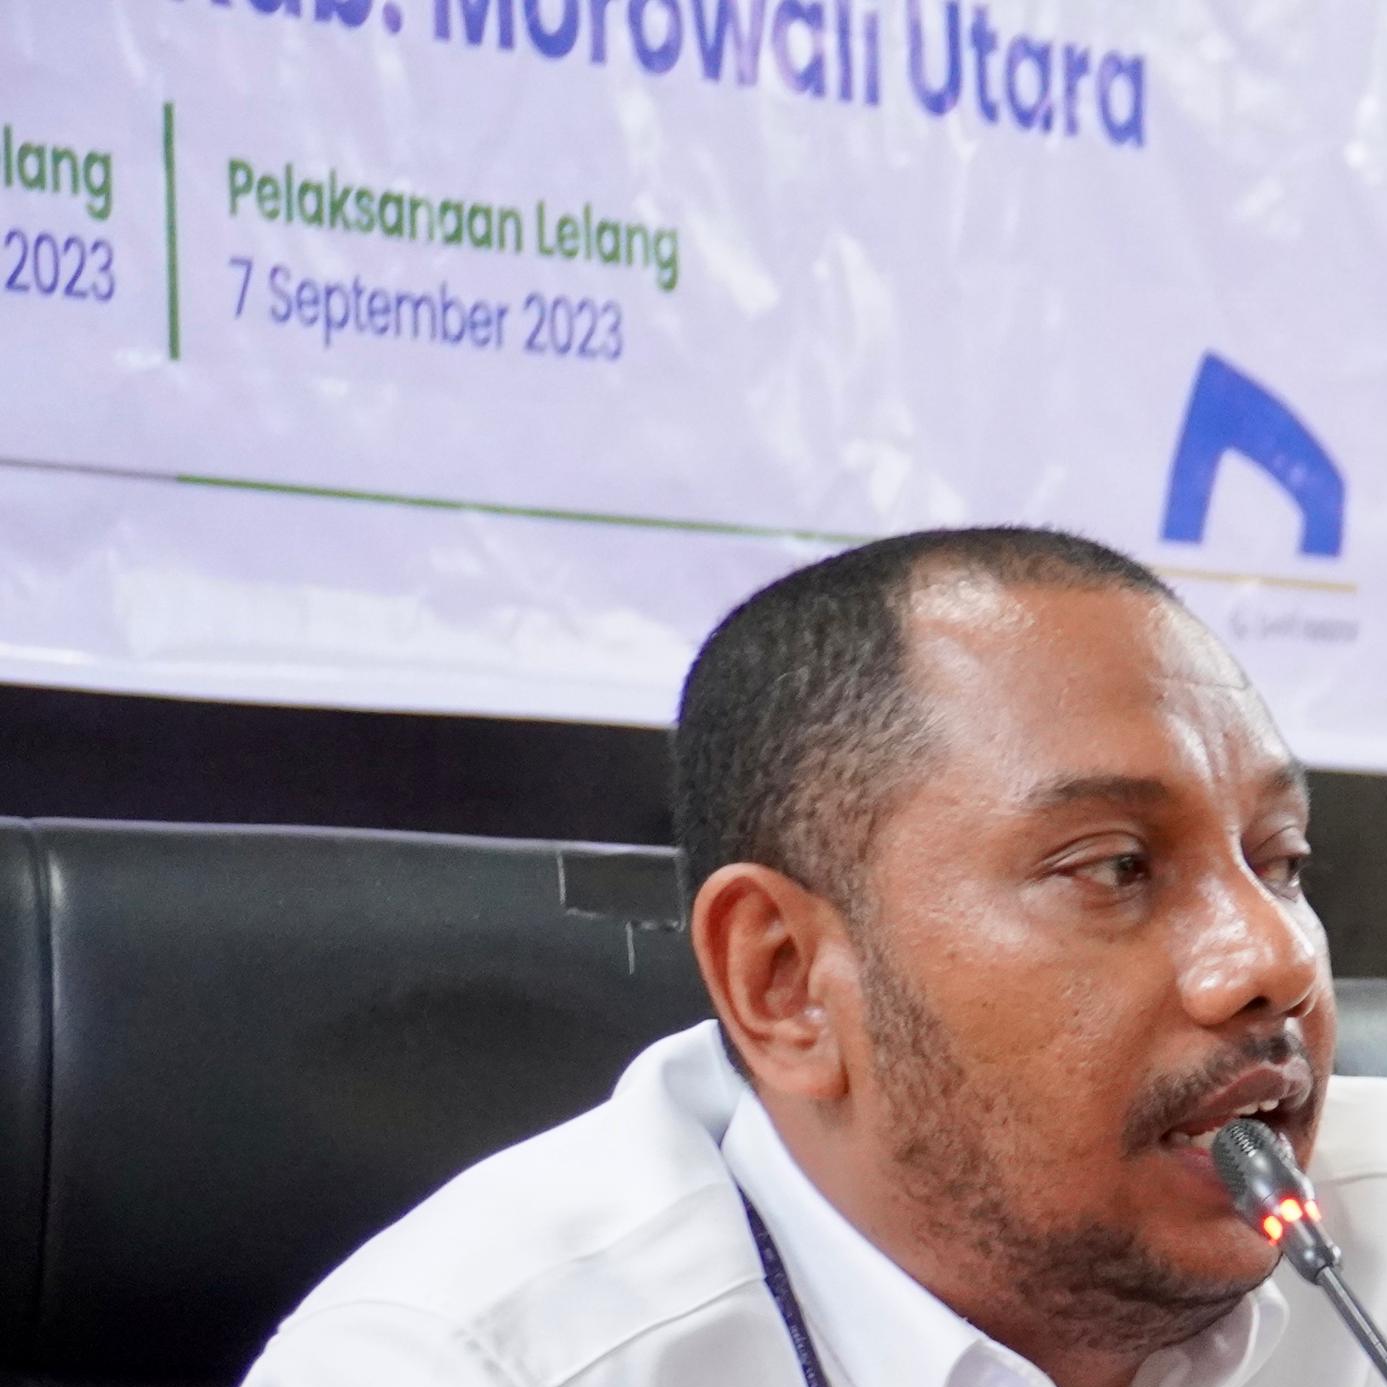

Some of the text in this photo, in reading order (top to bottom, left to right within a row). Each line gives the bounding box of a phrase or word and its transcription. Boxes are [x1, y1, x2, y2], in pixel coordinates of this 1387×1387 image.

[908, 0, 1146, 148] Utara
[4, 228, 116, 304] 2023
[228, 158, 679, 291] Pelaksanaan Lelang
[228, 256, 625, 361] 7 September 2023
